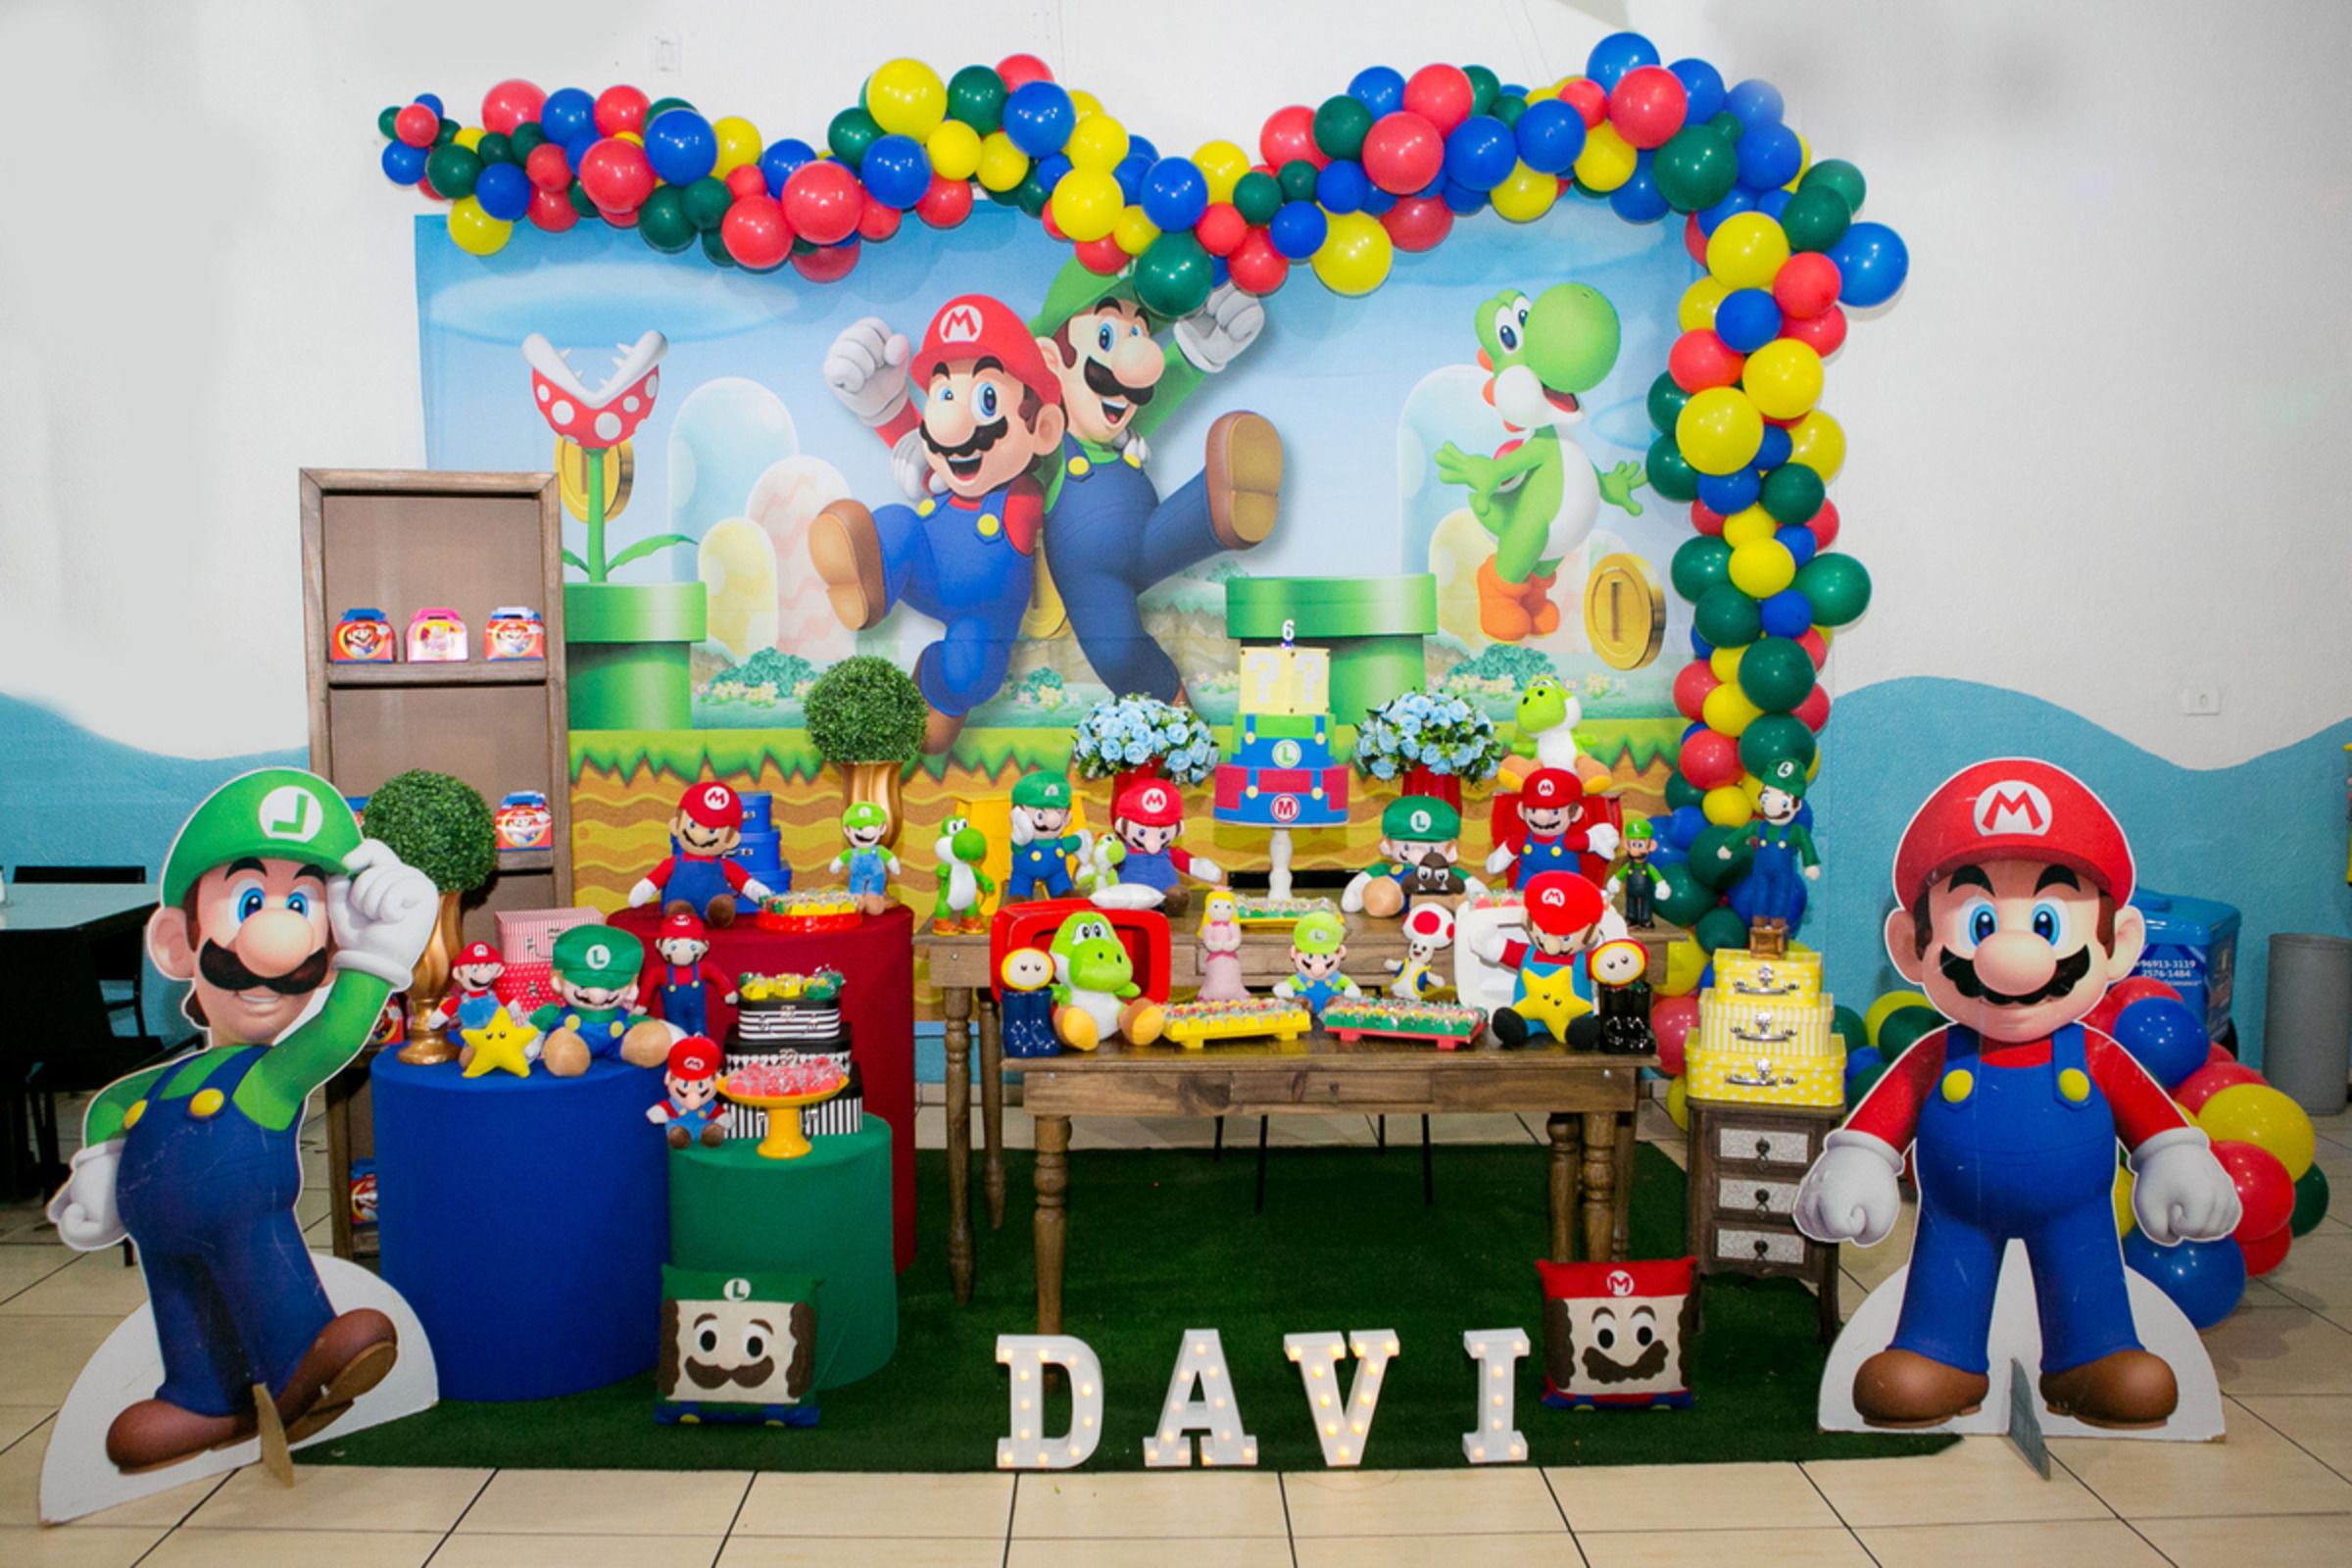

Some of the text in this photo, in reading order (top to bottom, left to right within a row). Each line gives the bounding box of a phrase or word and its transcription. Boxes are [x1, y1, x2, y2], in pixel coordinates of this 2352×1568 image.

[944, 309, 977, 339] M
[1281, 619, 1295, 642] 6
[1282, 746, 1295, 762] L
[708, 791, 725, 804] M
[1146, 794, 1163, 806] M
[1277, 800, 1295, 816] M
[1981, 788, 2044, 831] M
[1416, 814, 1427, 827] L
[592, 950, 605, 964] L
[732, 1280, 747, 1298] L
[1610, 1275, 1631, 1293] M
[996, 1328, 1529, 1469] DAVI
